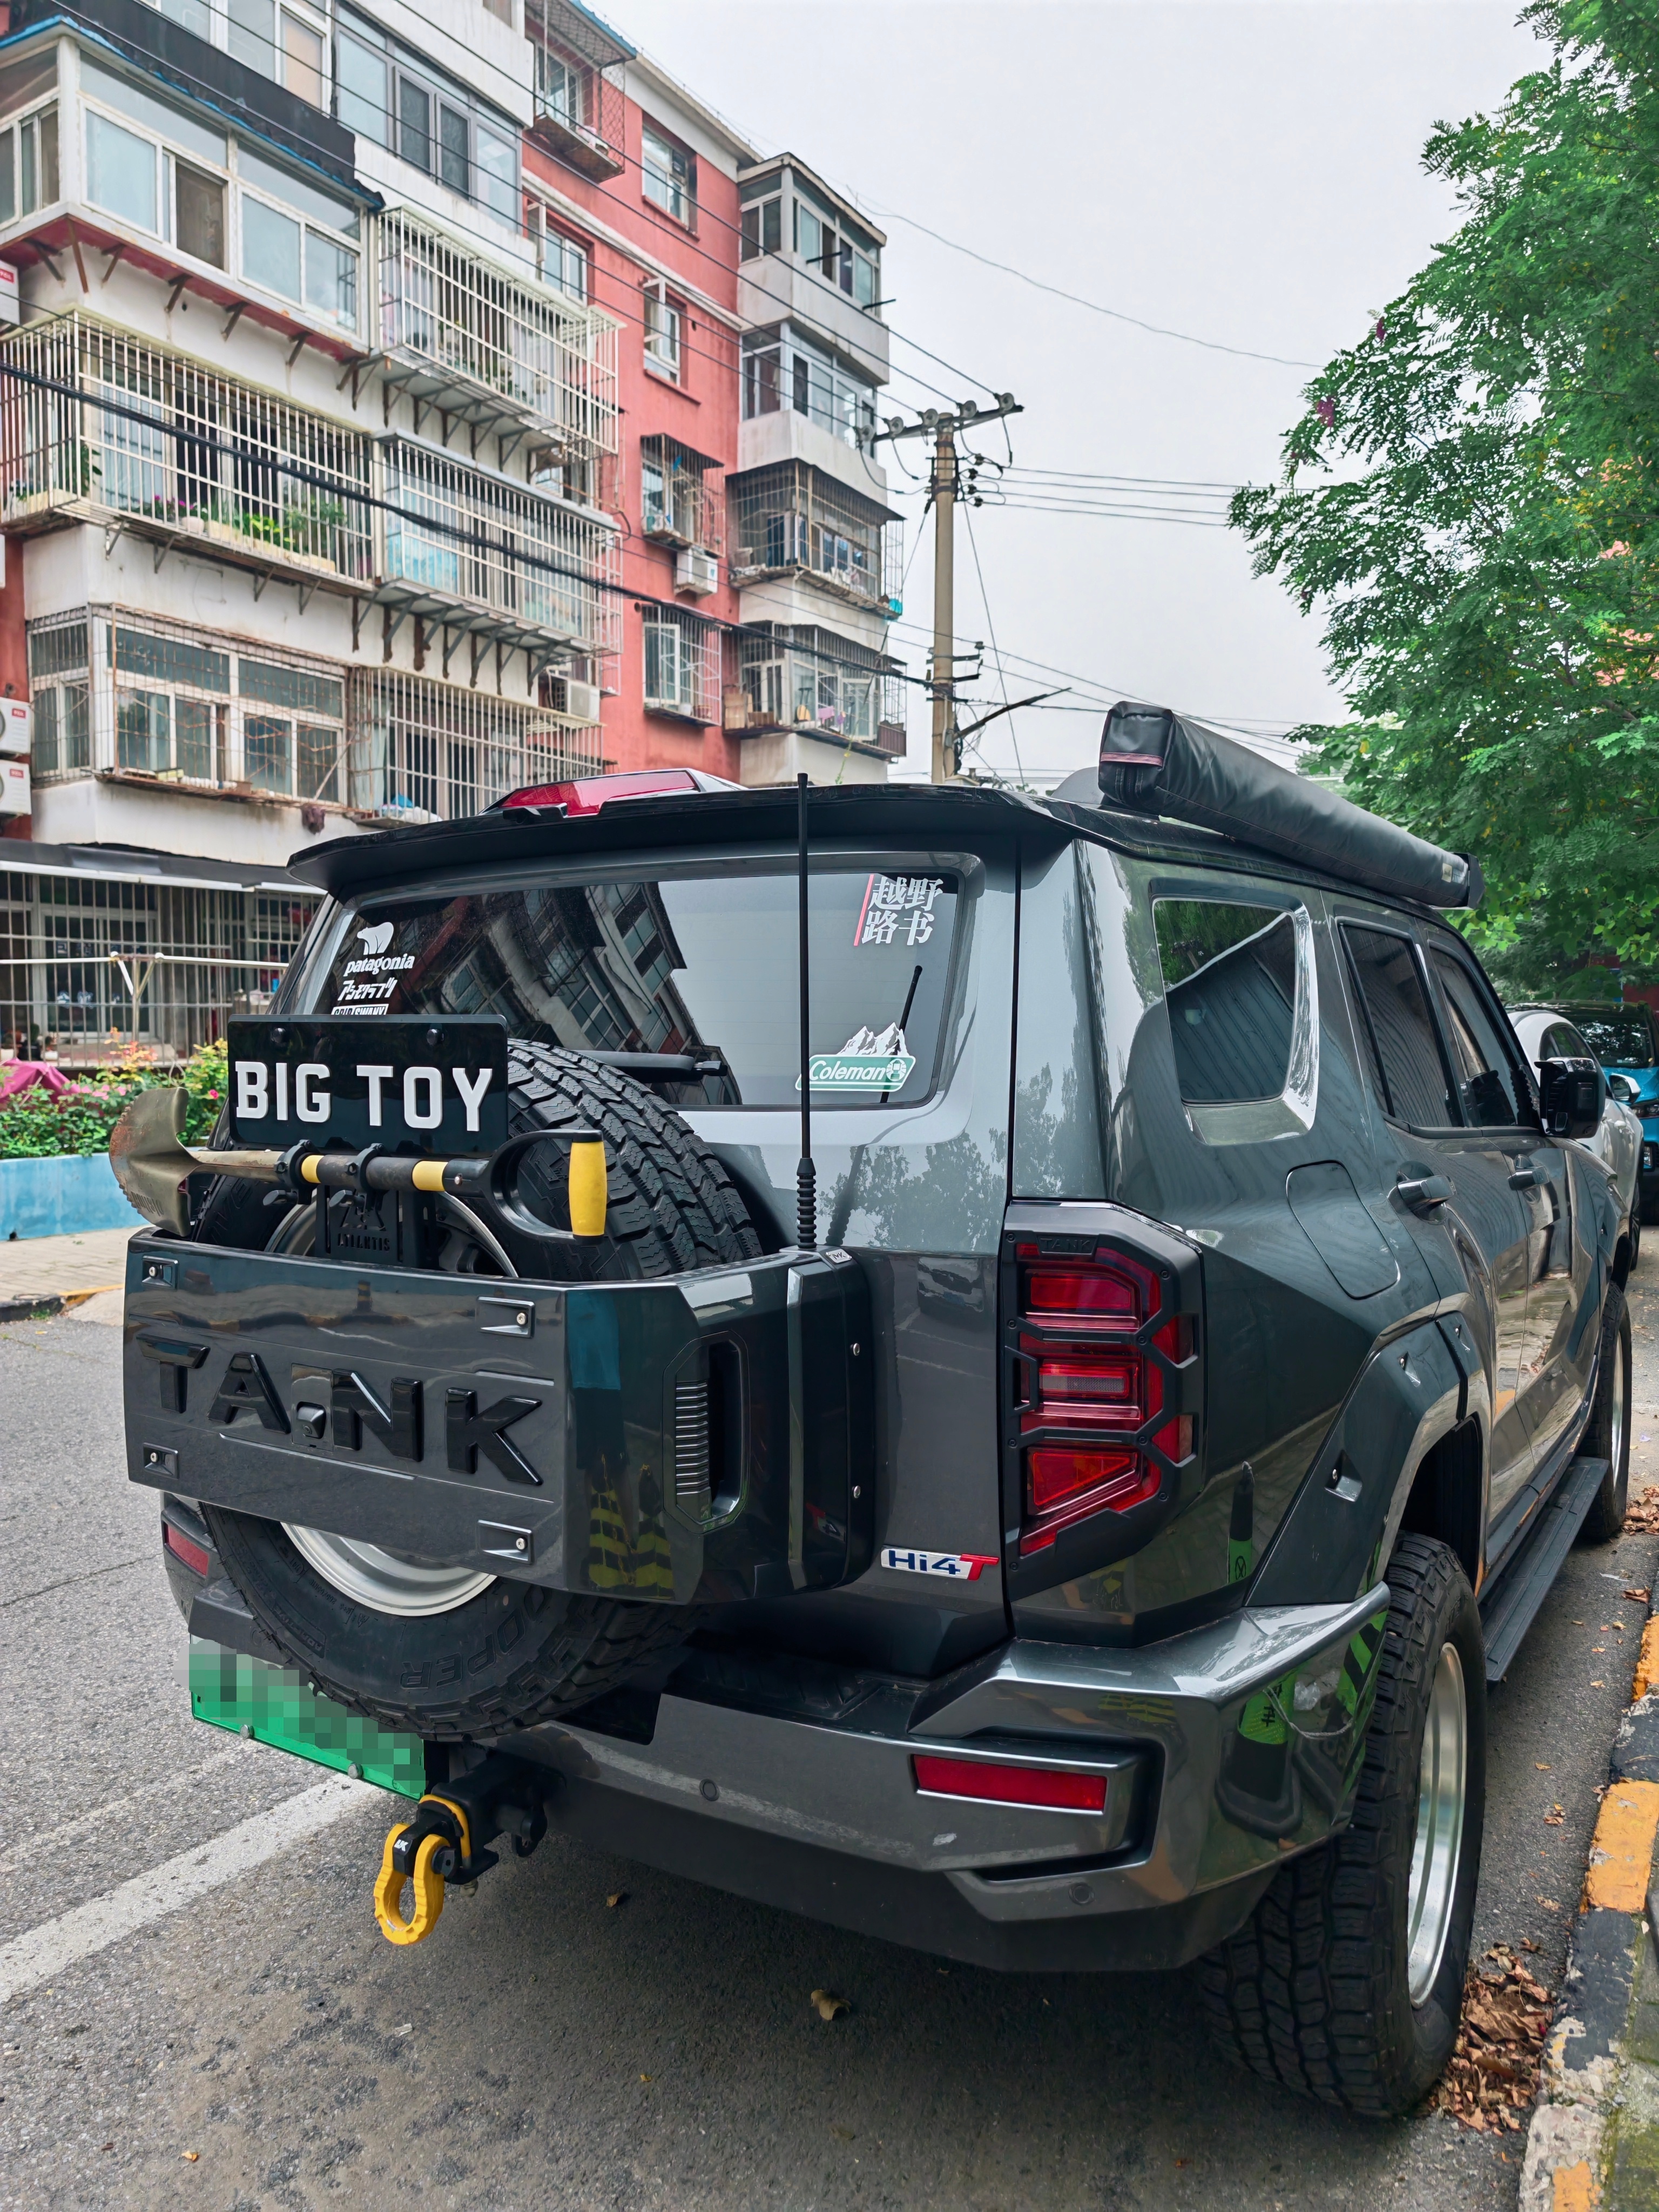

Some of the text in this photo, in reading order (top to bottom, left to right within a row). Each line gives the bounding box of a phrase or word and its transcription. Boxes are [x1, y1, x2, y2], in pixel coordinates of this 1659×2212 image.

[868, 876, 943, 911] 越野
[862, 910, 934, 945] 路书
[343, 954, 415, 976] patagonia
[810, 1060, 886, 1080] Coleman
[235, 1061, 493, 1132] BIG TOY
[338, 1233, 390, 1252] ATLANTIS
[1040, 1238, 1090, 1251] TANK
[136, 1333, 543, 1486] TANK
[888, 1549, 1000, 1581] Hi4T
[400, 1582, 552, 1689] OOPER
